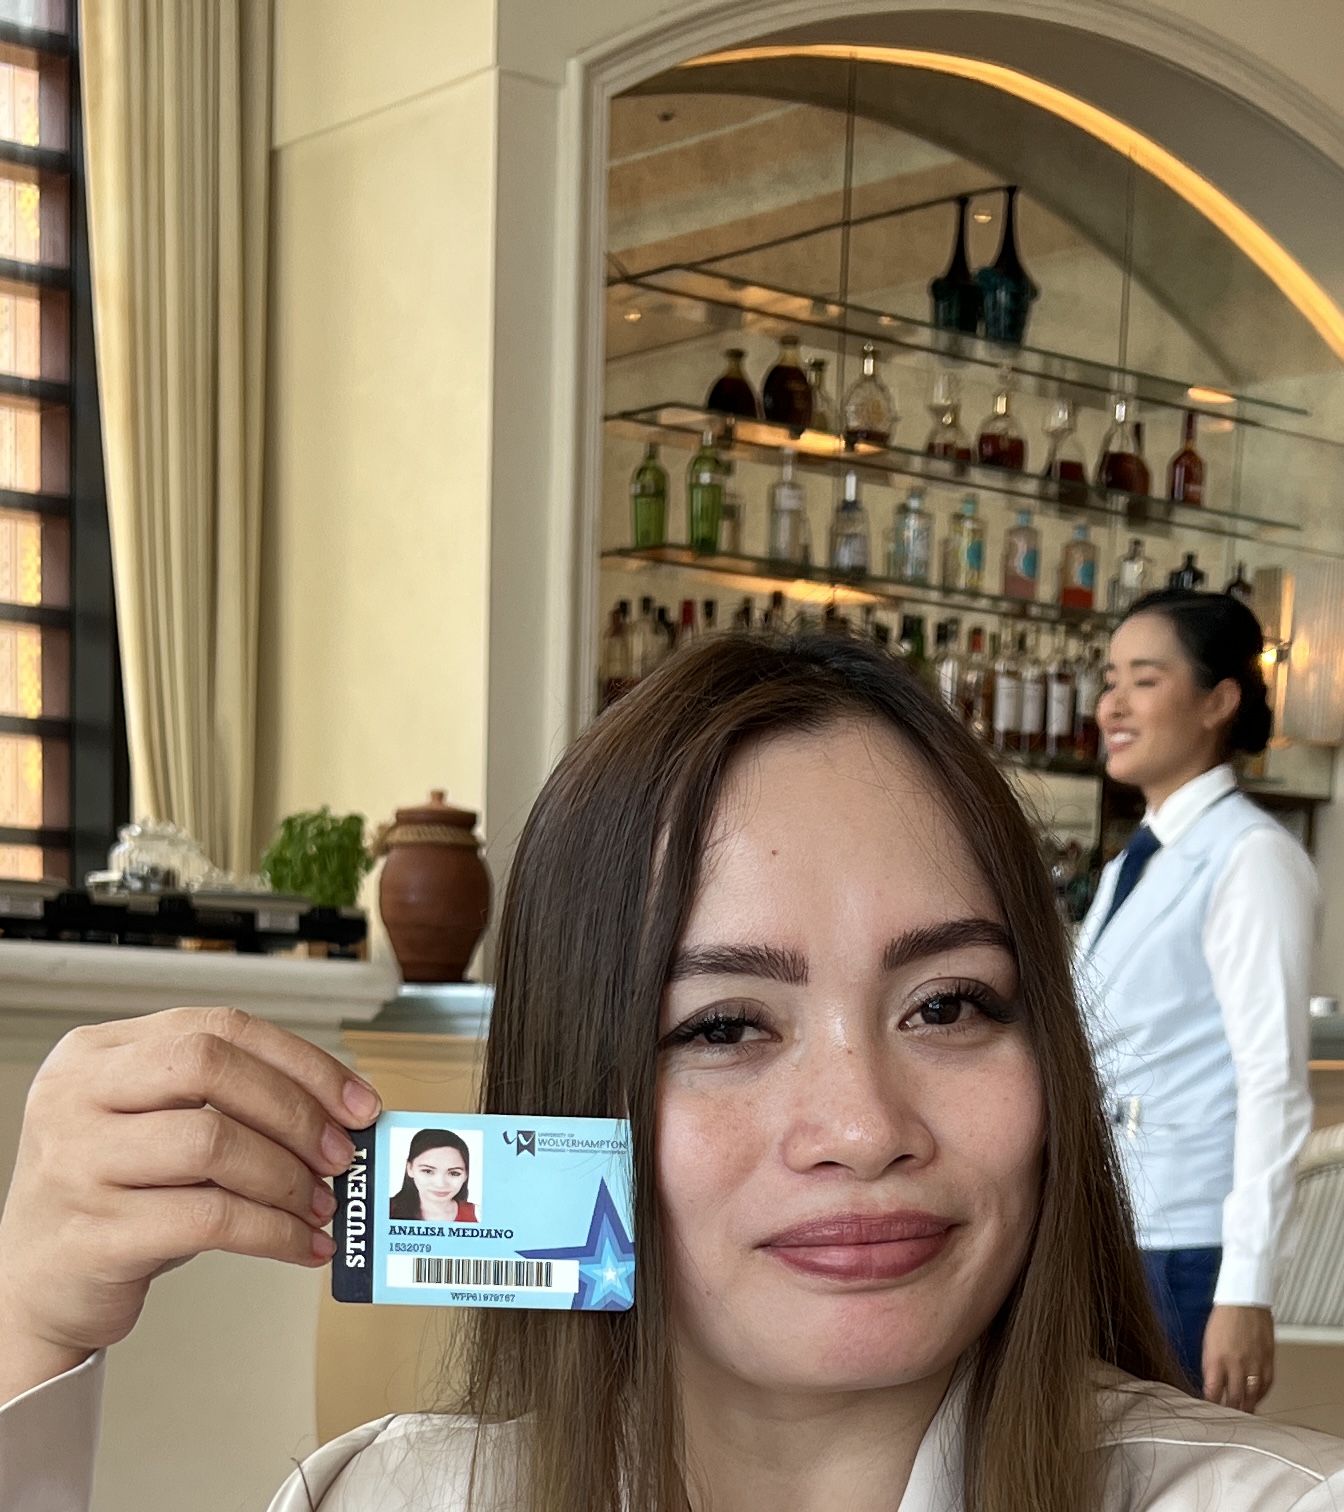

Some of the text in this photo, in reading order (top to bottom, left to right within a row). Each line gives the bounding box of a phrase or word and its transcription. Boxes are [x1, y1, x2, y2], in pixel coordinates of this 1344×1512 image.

[537, 1138, 627, 1149] WOLVERHAMPTON
[388, 1225, 514, 1239] ANALISA MEDIANO
[389, 1242, 432, 1253] 1532079
